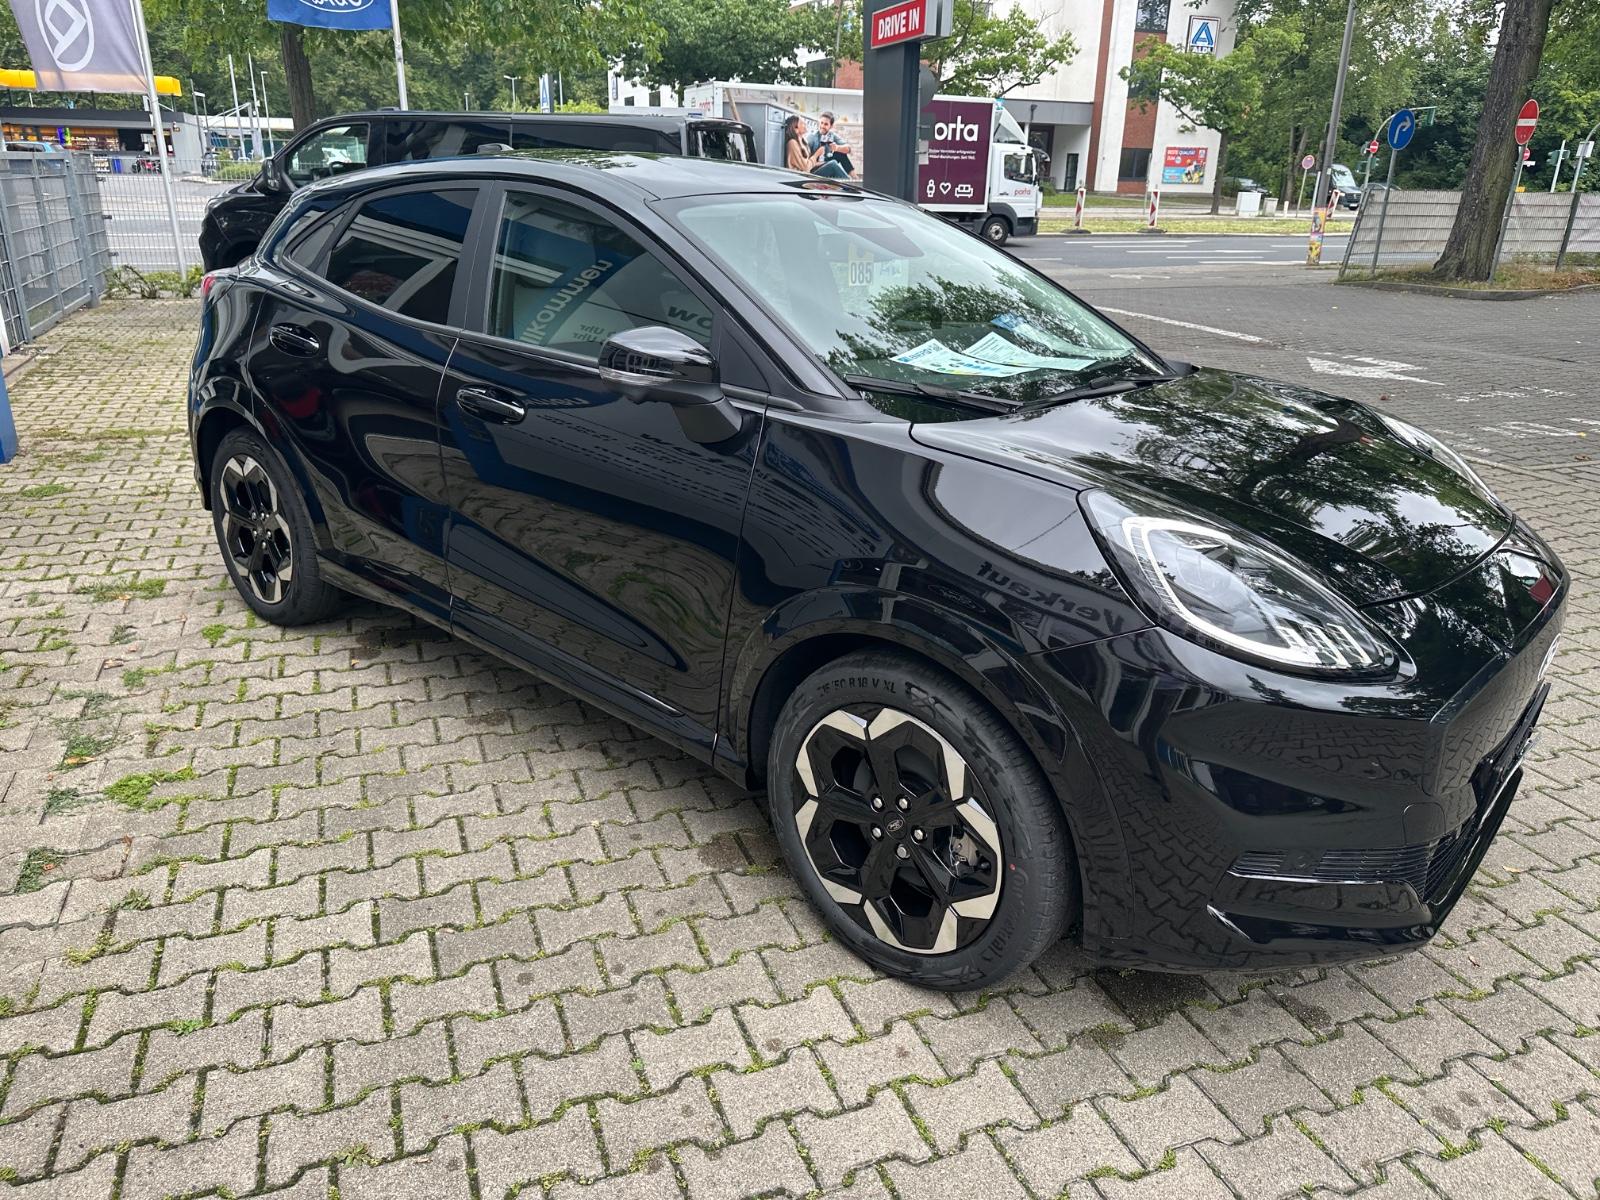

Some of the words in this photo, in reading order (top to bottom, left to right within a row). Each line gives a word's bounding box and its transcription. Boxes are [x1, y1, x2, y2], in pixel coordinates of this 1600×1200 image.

[878, 11, 906, 40] DRIVE
[908, 6, 920, 32] IN
[934, 115, 979, 142] orta
[1014, 187, 1031, 196] porta
[850, 262, 872, 284] 085
